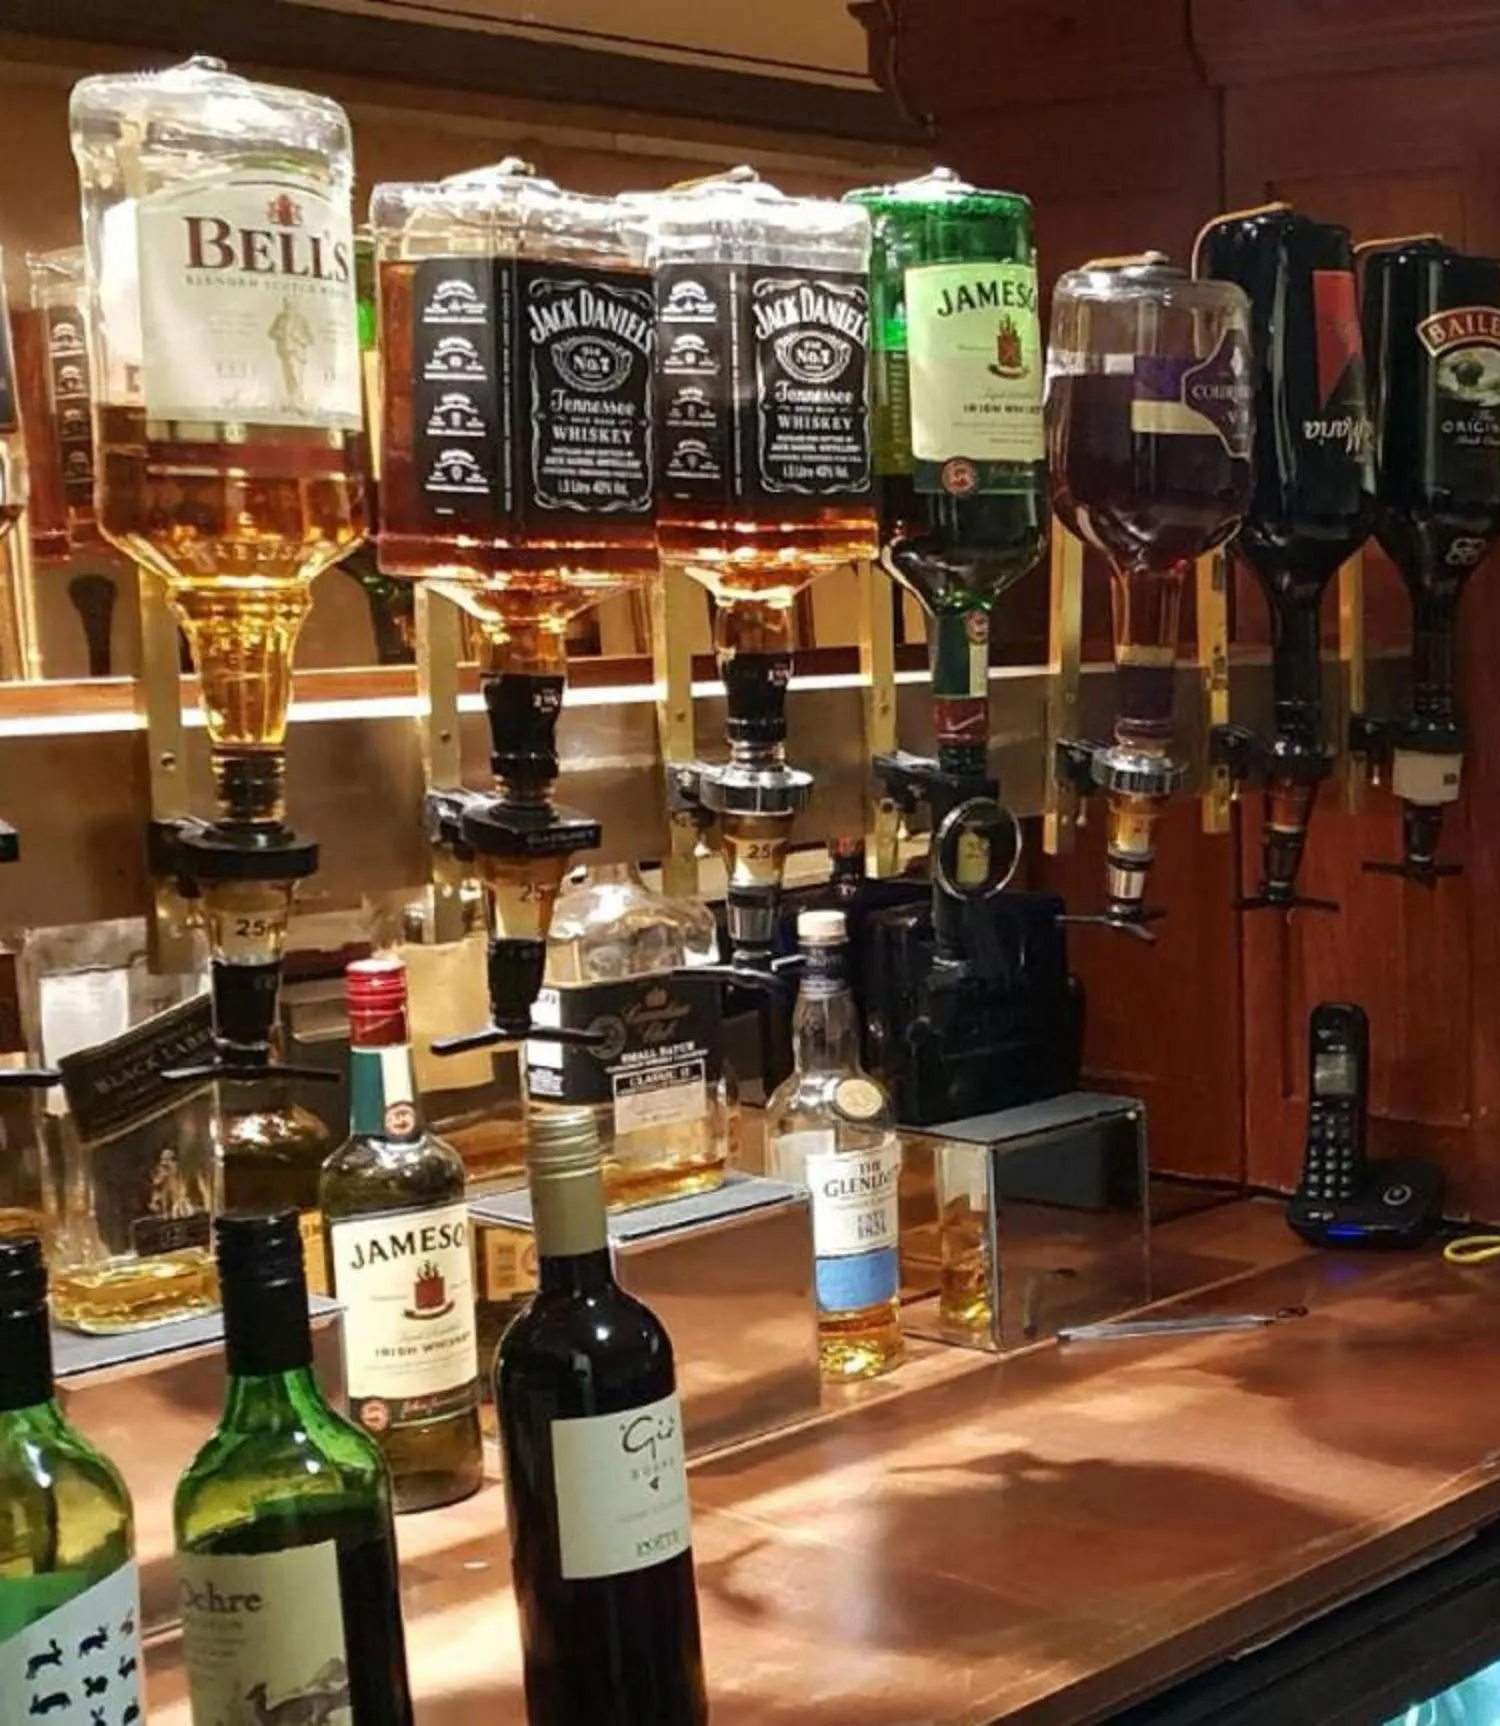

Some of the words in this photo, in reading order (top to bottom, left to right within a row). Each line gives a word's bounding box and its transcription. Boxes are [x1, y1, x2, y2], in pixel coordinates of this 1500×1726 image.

[182, 215, 349, 283] BELL'S
[528, 296, 577, 343] JACK
[752, 294, 799, 340] JACK
[551, 424, 634, 445] WHISKEY
[777, 414, 853, 431] WHISKEY
[859, 1159, 881, 1174] THE
